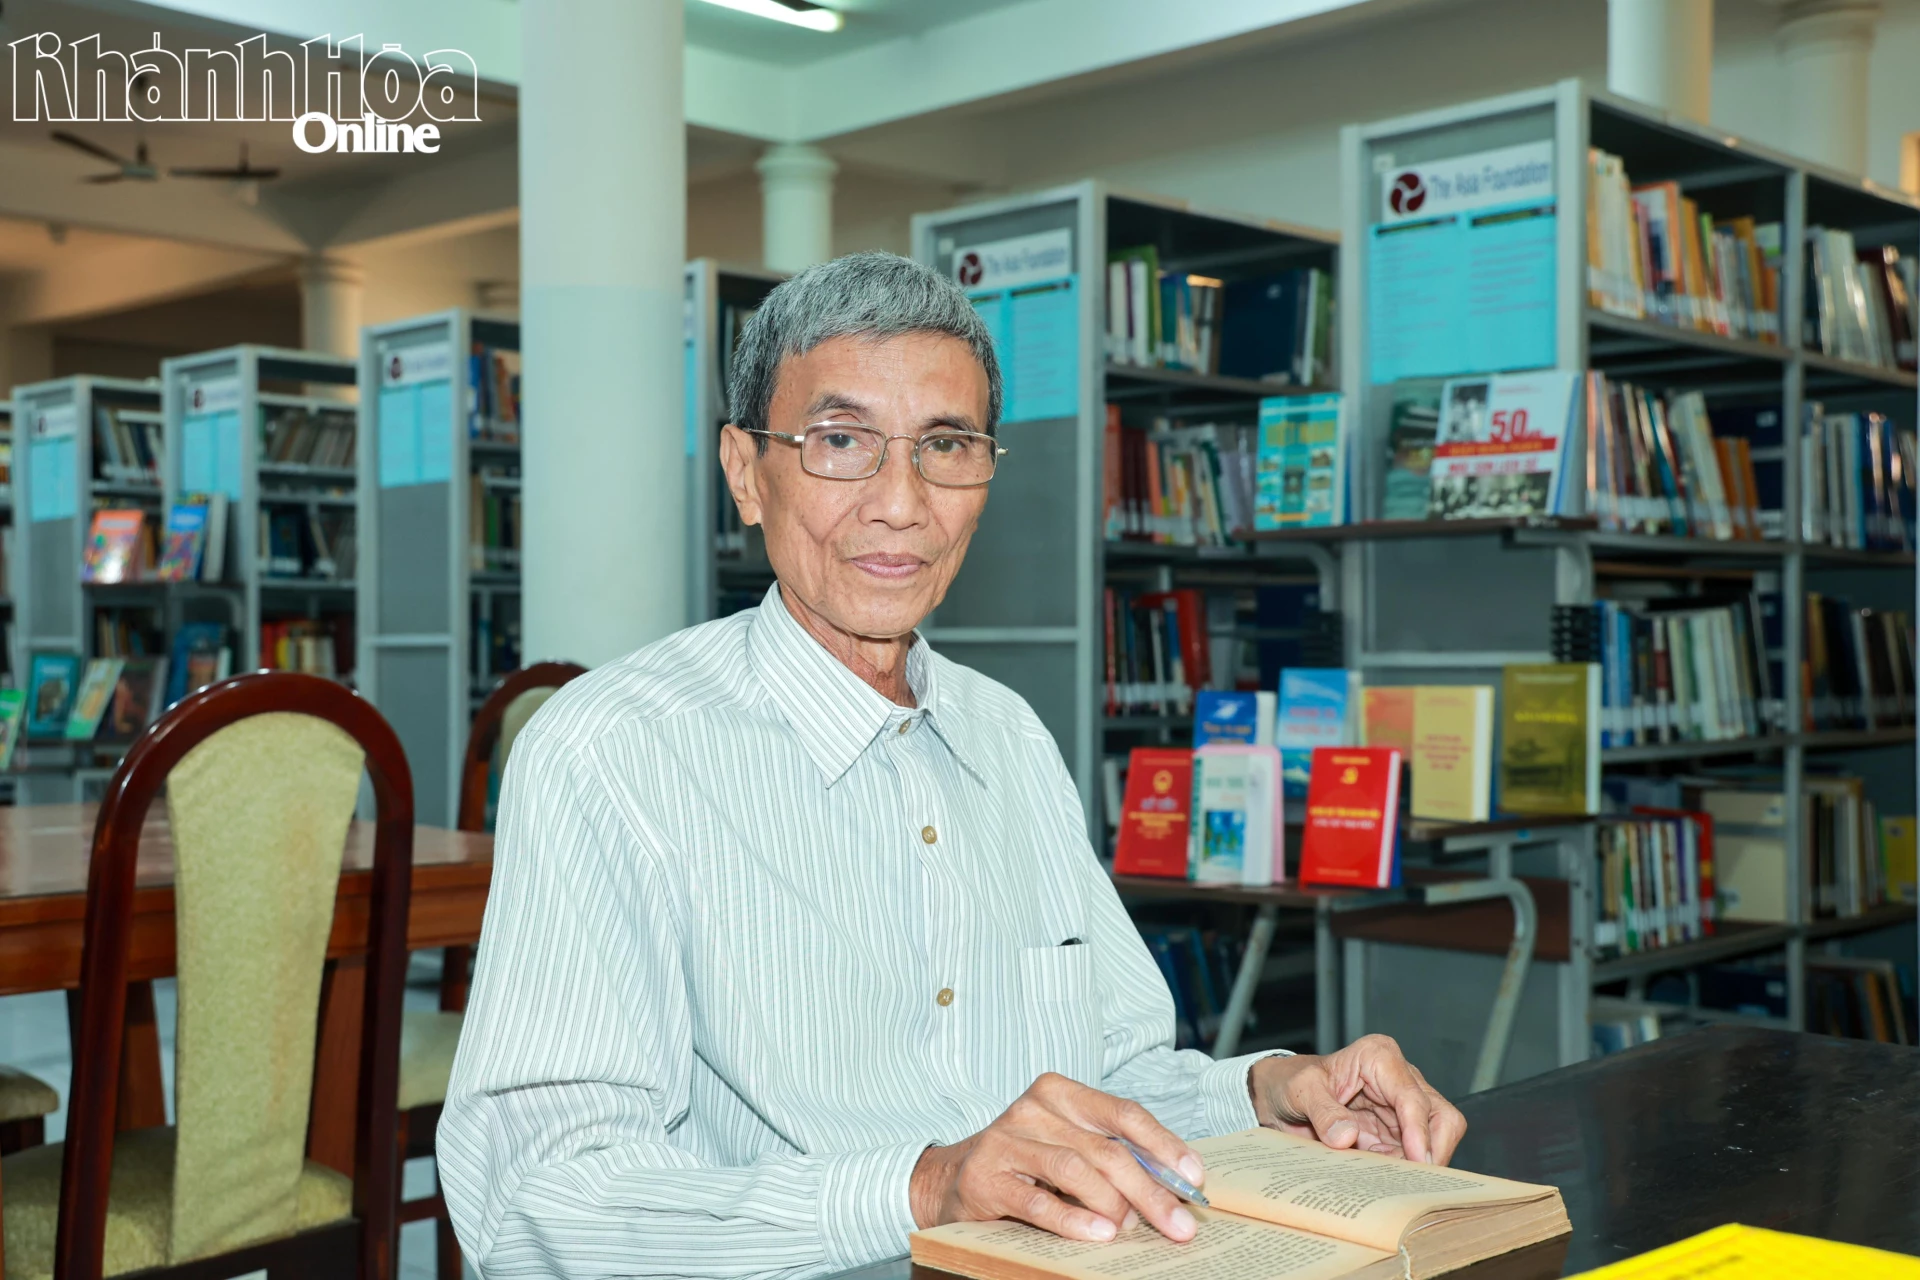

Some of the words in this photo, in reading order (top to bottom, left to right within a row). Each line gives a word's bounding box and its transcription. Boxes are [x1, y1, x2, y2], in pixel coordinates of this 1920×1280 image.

[1429, 174, 1451, 199] The
[1455, 171, 1480, 195] Asia
[1482, 160, 1550, 191] Foundation
[1491, 409, 1527, 441] 50
